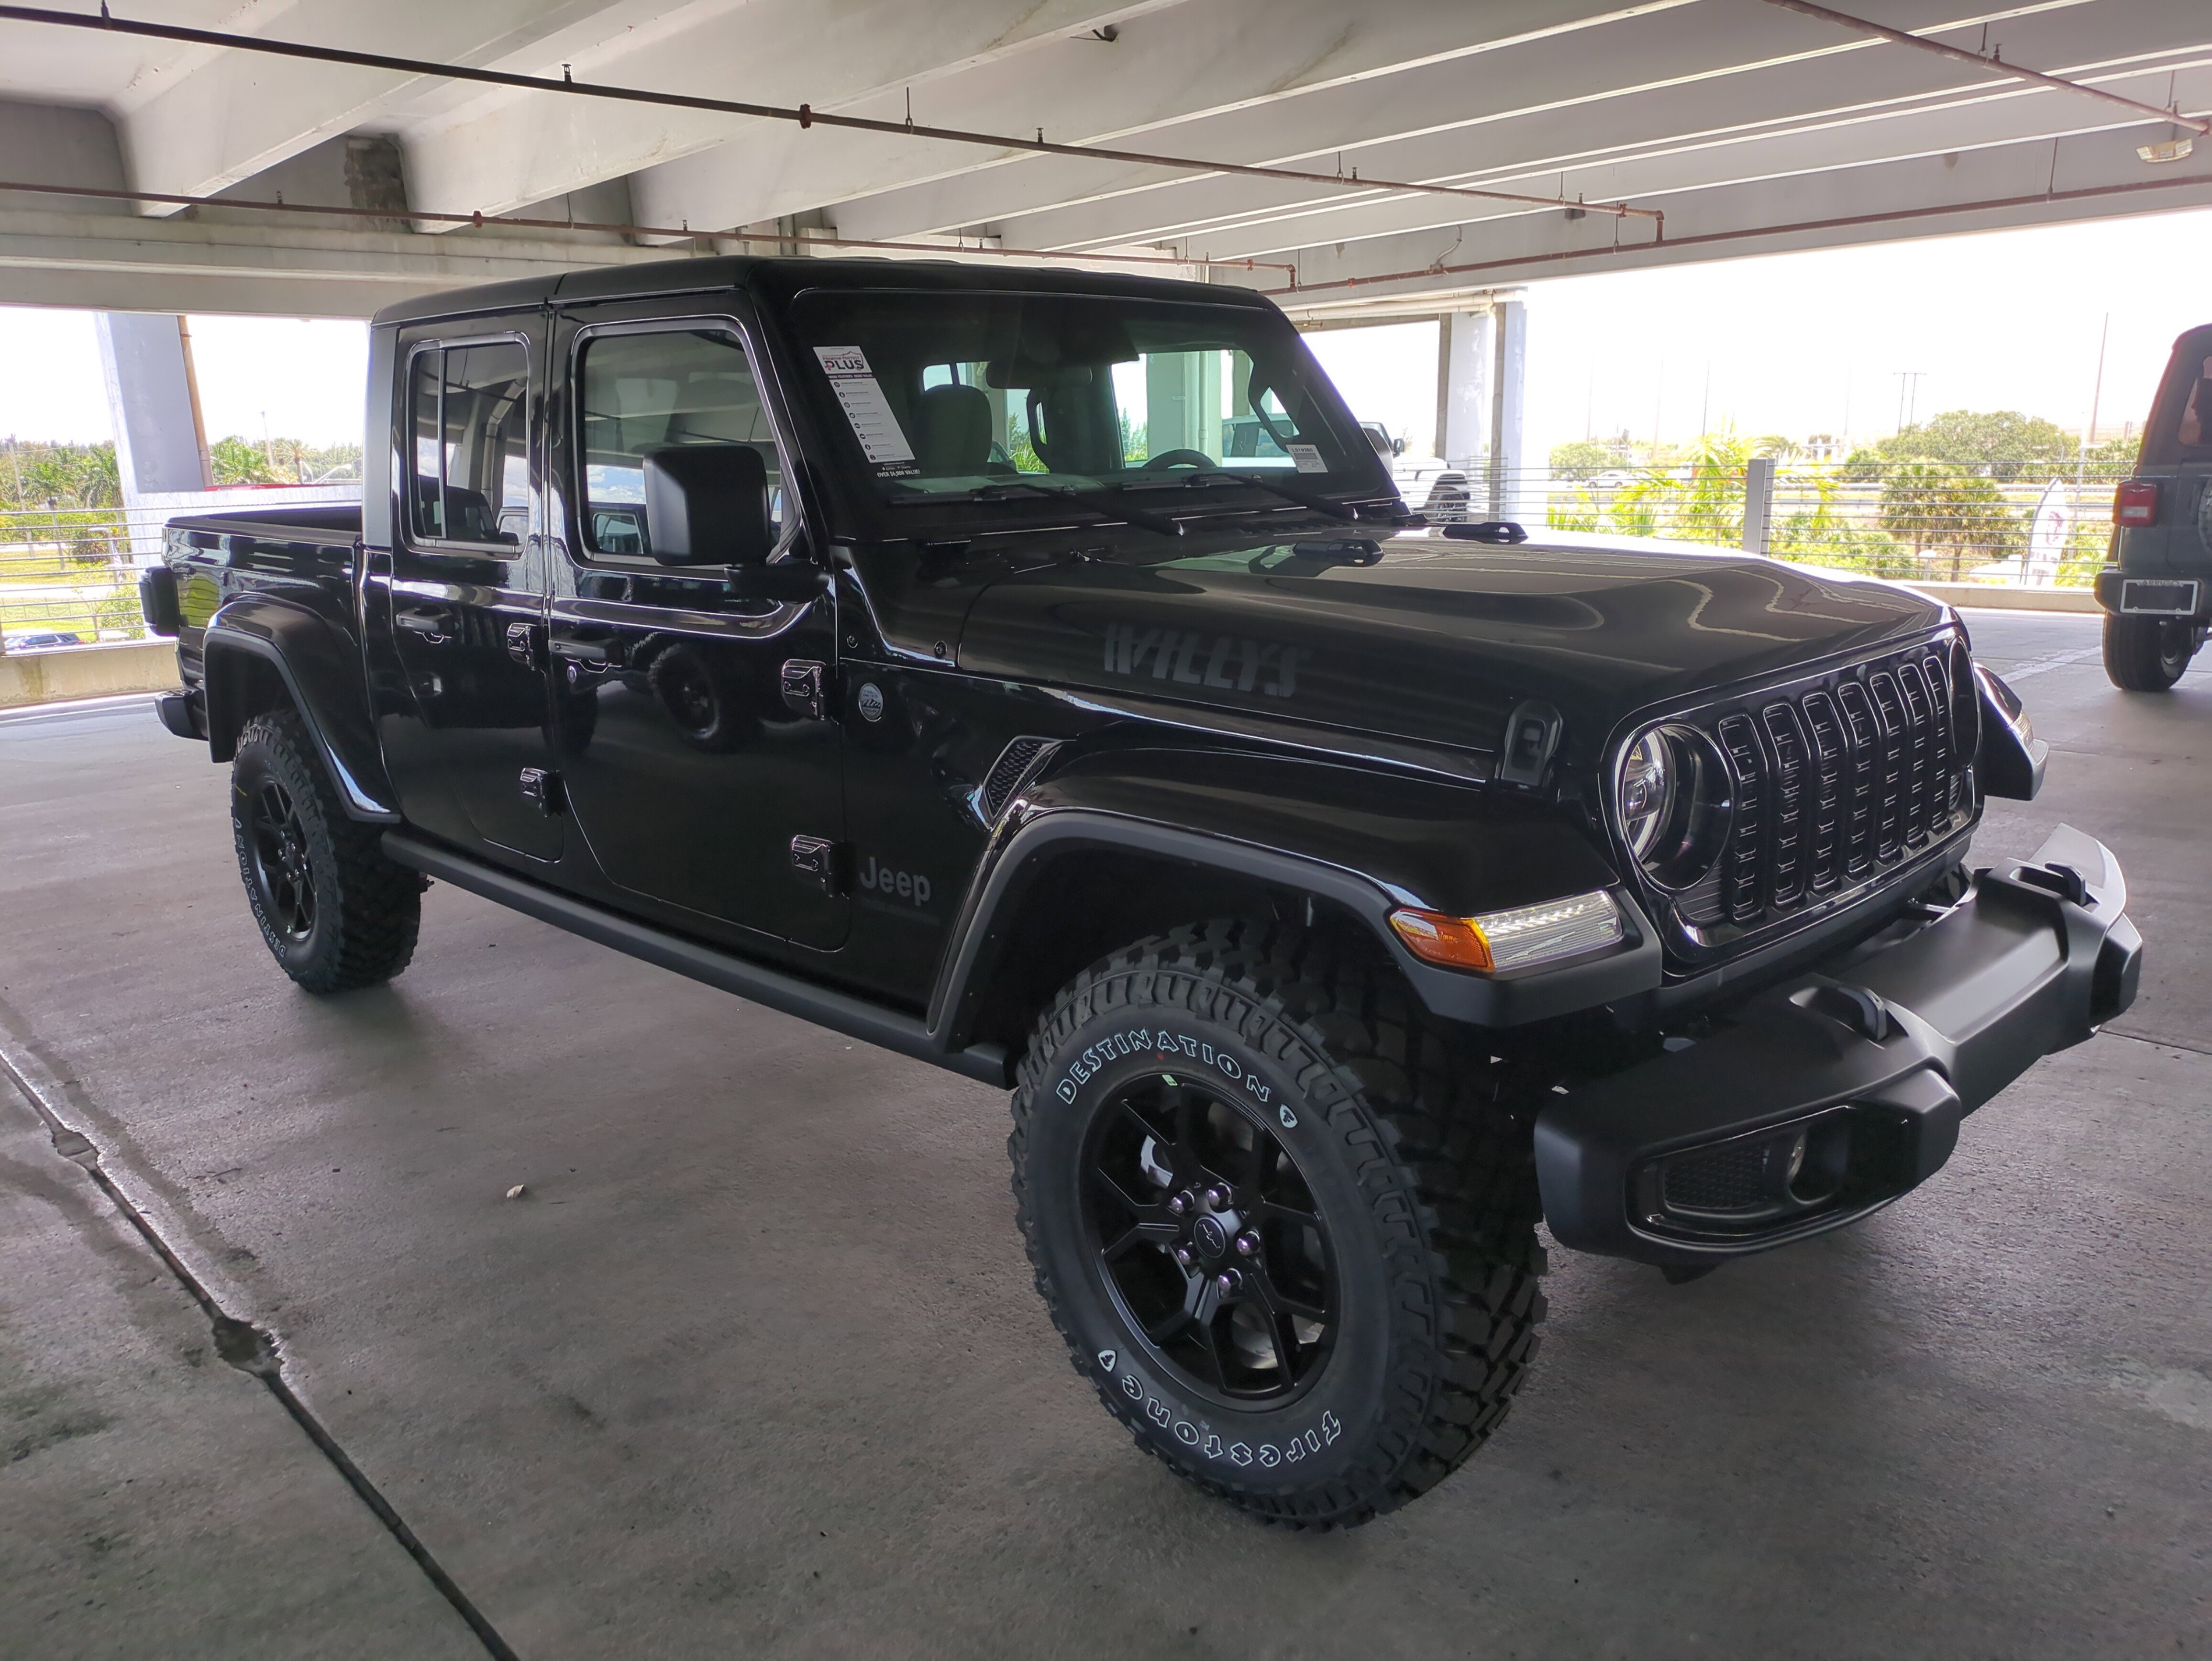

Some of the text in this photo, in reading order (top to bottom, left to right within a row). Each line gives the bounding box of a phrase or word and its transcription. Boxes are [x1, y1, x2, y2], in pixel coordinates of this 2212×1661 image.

[824, 359, 864, 371] PLUS
[1105, 623, 1312, 698] WILLYS
[236, 835, 286, 957] DESTINATION
[860, 856, 930, 906] Jeep
[1056, 1027, 1272, 1105] DESTINATION
